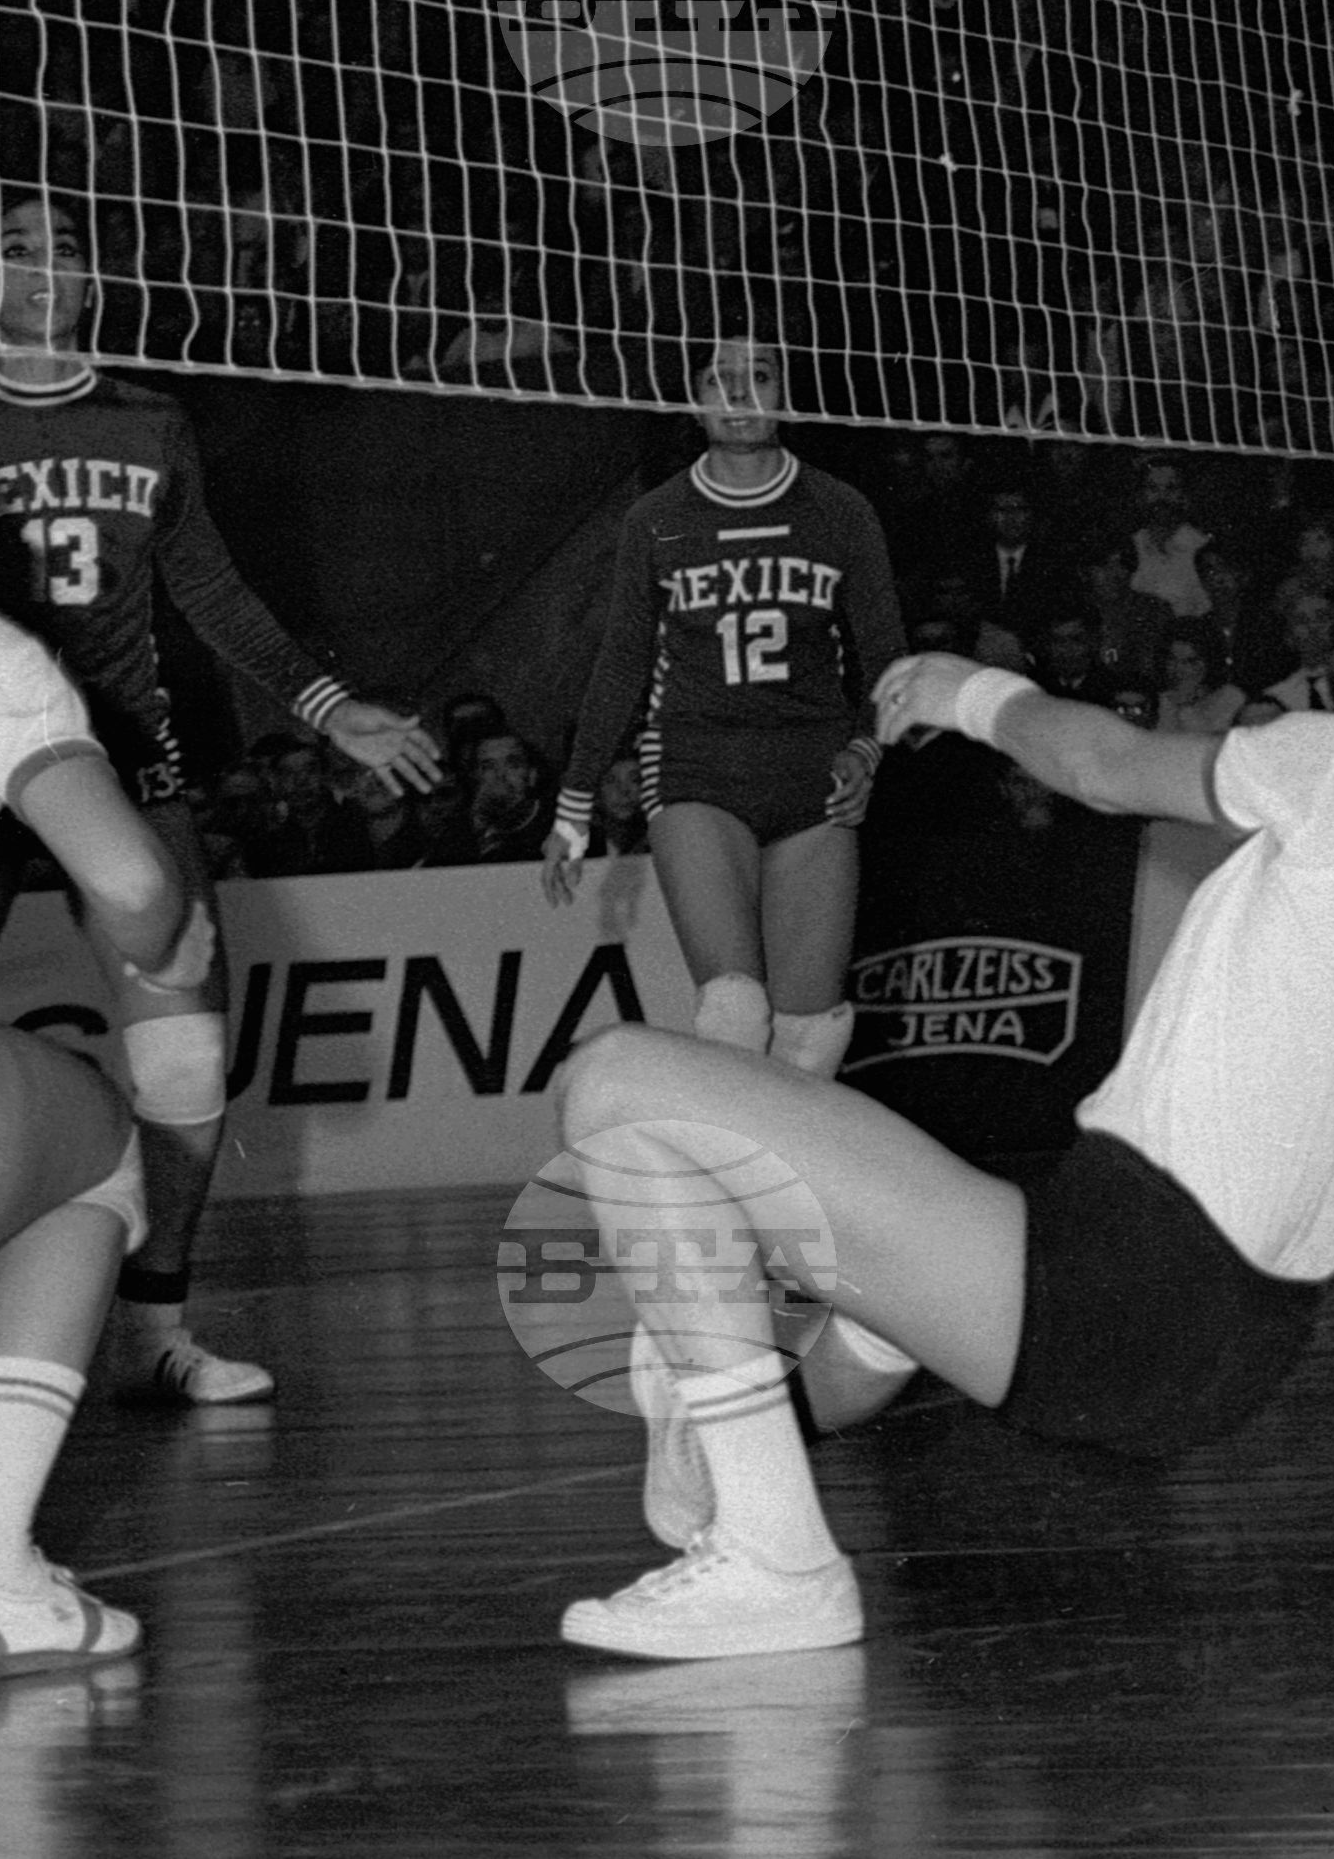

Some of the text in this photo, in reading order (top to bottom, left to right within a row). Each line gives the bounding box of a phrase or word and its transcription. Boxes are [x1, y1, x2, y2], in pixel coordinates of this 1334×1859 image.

[20, 516, 100, 606] 13
[659, 556, 842, 612] MEXICO
[716, 608, 789, 685] 12
[887, 1009, 1026, 1047] JENA
